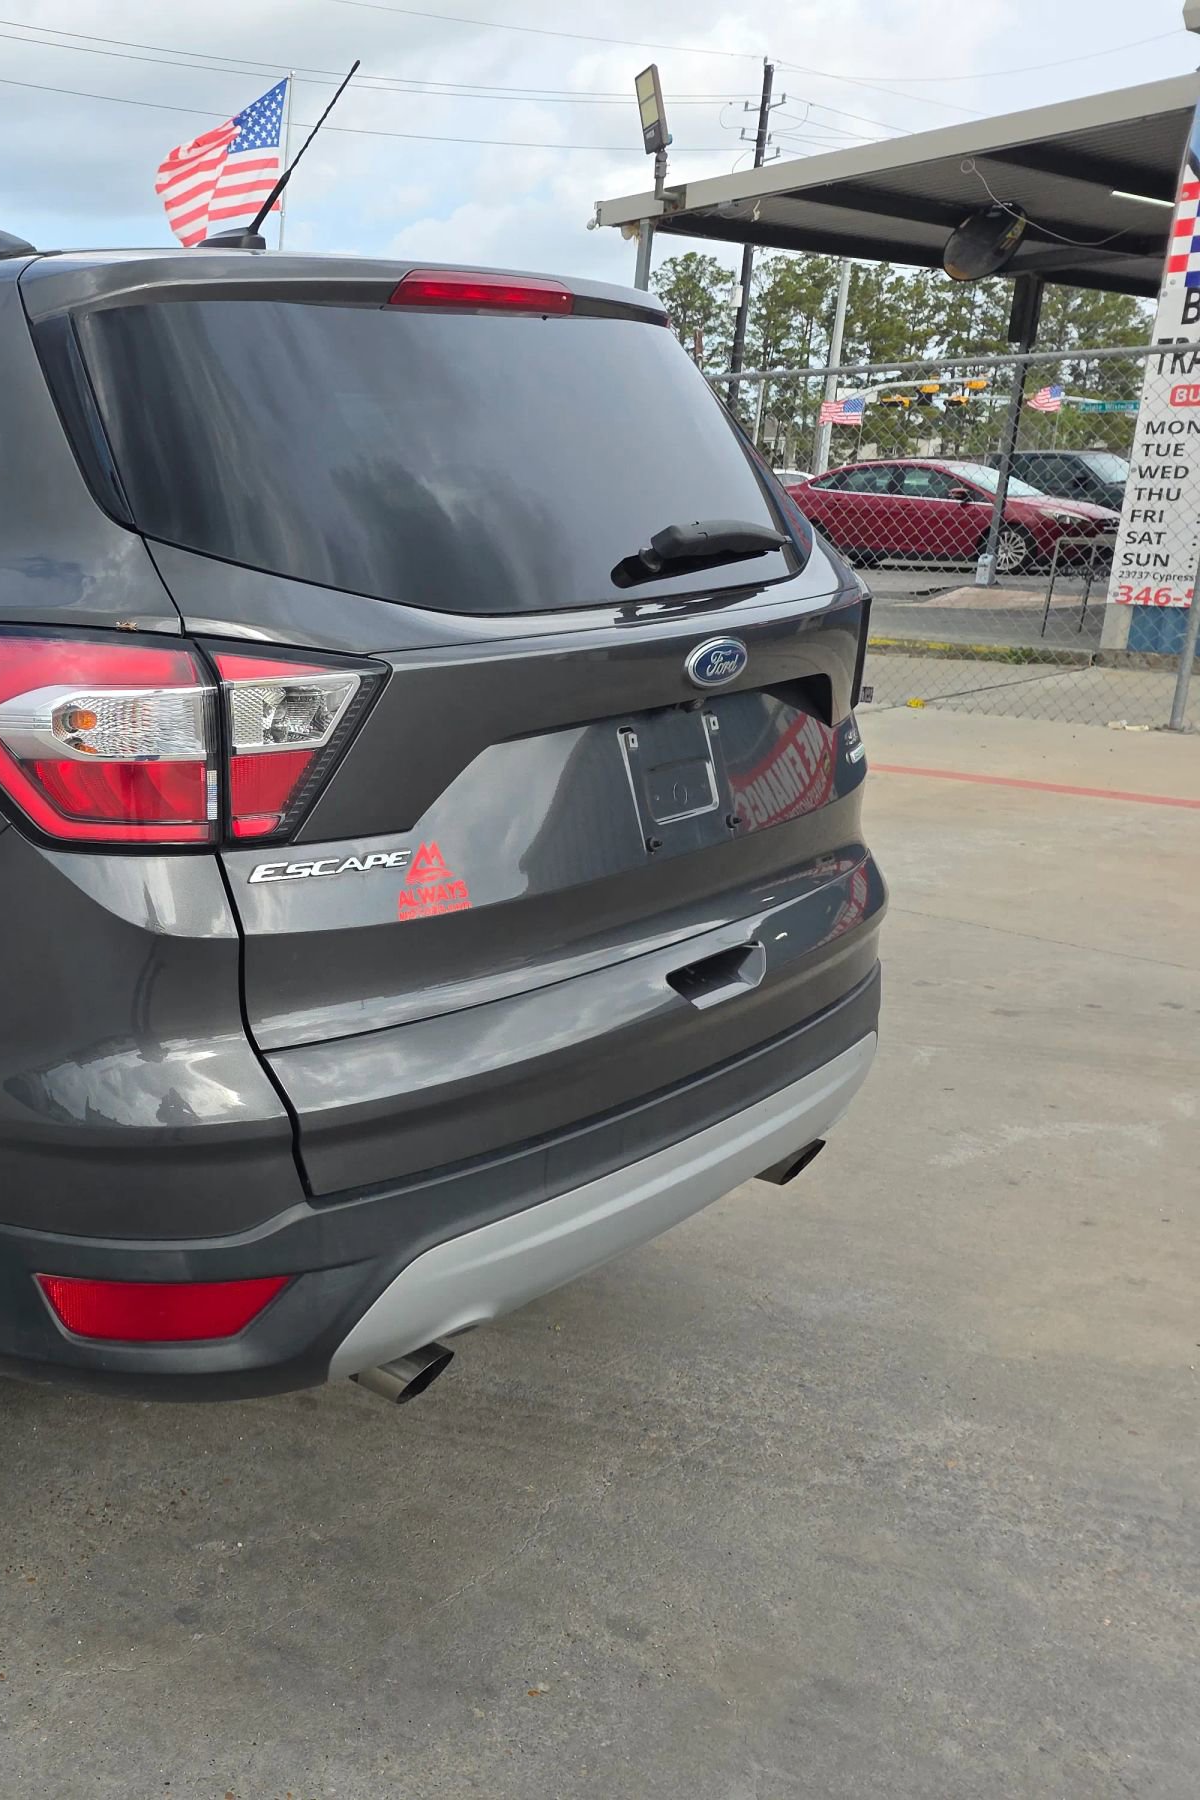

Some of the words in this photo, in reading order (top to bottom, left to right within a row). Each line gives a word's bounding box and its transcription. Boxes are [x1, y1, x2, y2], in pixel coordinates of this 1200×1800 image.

[1145, 420, 1200, 435] MON
[1141, 443, 1185, 457] TUE
[1138, 465, 1189, 479] WED
[1134, 487, 1181, 502] THU
[1130, 509, 1164, 523] FRI
[1125, 530, 1167, 545] SAT
[1121, 552, 1170, 567] SUN
[1152, 572, 1194, 582] Cypress
[706, 650, 739, 677] Ford
[249, 850, 412, 884] ESCAPE
[398, 880, 469, 910] ALWAYS
